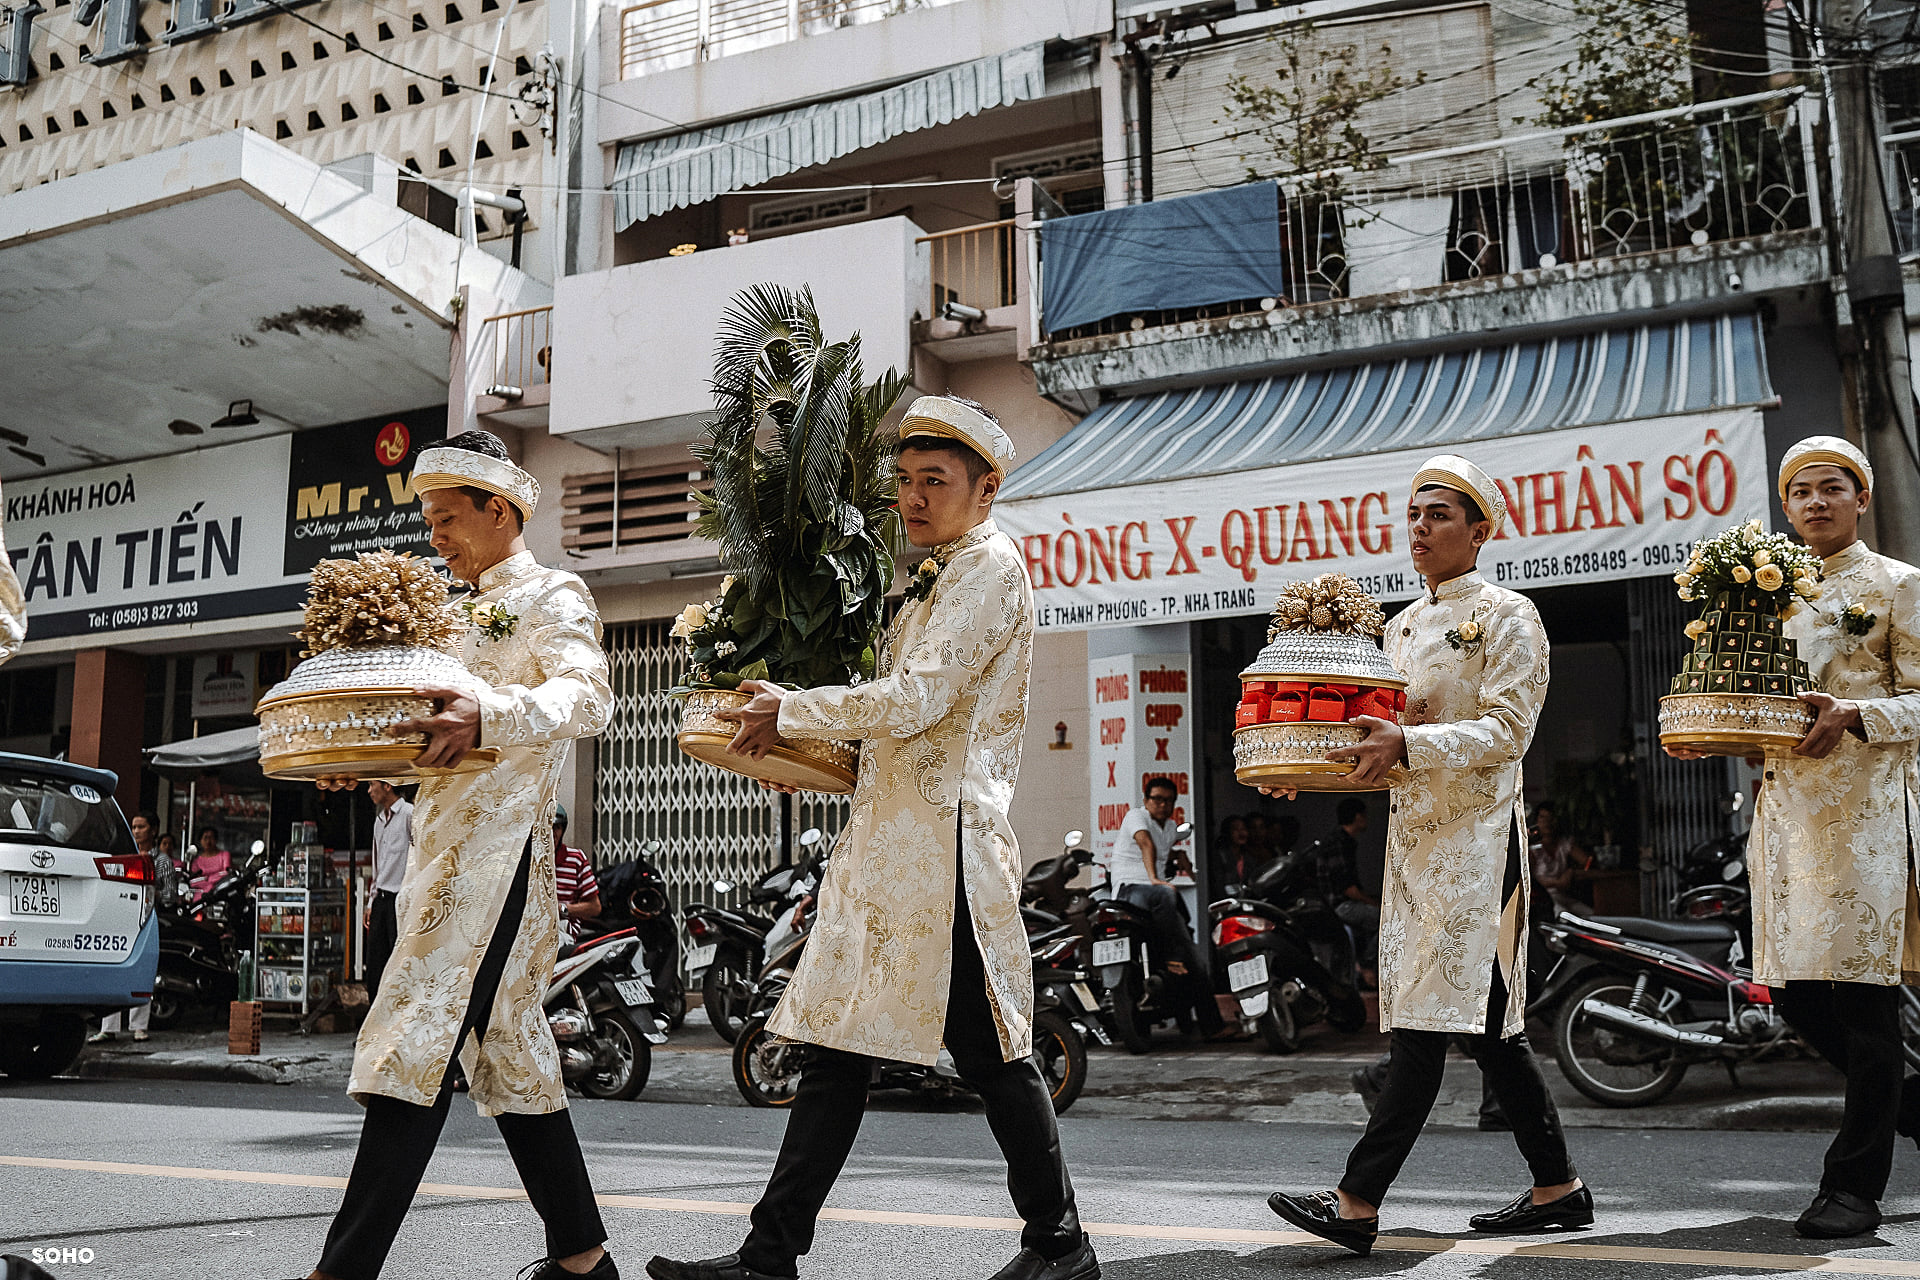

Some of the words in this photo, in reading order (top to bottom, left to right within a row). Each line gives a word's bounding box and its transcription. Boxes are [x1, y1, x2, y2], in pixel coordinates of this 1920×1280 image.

[7, 487, 83, 522] KHÁNH
[88, 473, 136, 509] HOÀ
[296, 482, 381, 520] Mr.
[1012, 512, 1154, 590] HÒNG
[1164, 491, 1394, 582] X-QUANG
[1492, 445, 1644, 540] NHÂN
[7, 532, 102, 603] TÂN
[115, 501, 242, 590] TIẾN
[1161, 596, 1180, 616] TP.
[1185, 593, 1210, 612] NHA
[1213, 588, 1255, 609] TRANG
[1523, 549, 1627, 579] 0258.6288489
[112, 606, 149, 629] (058)3
[152, 604, 173, 621] 827
[176, 601, 198, 619] 303
[1154, 738, 1170, 761] X
[1107, 761, 1117, 788] X
[22, 878, 47, 895] 79A
[14, 895, 58, 914] 164.56
